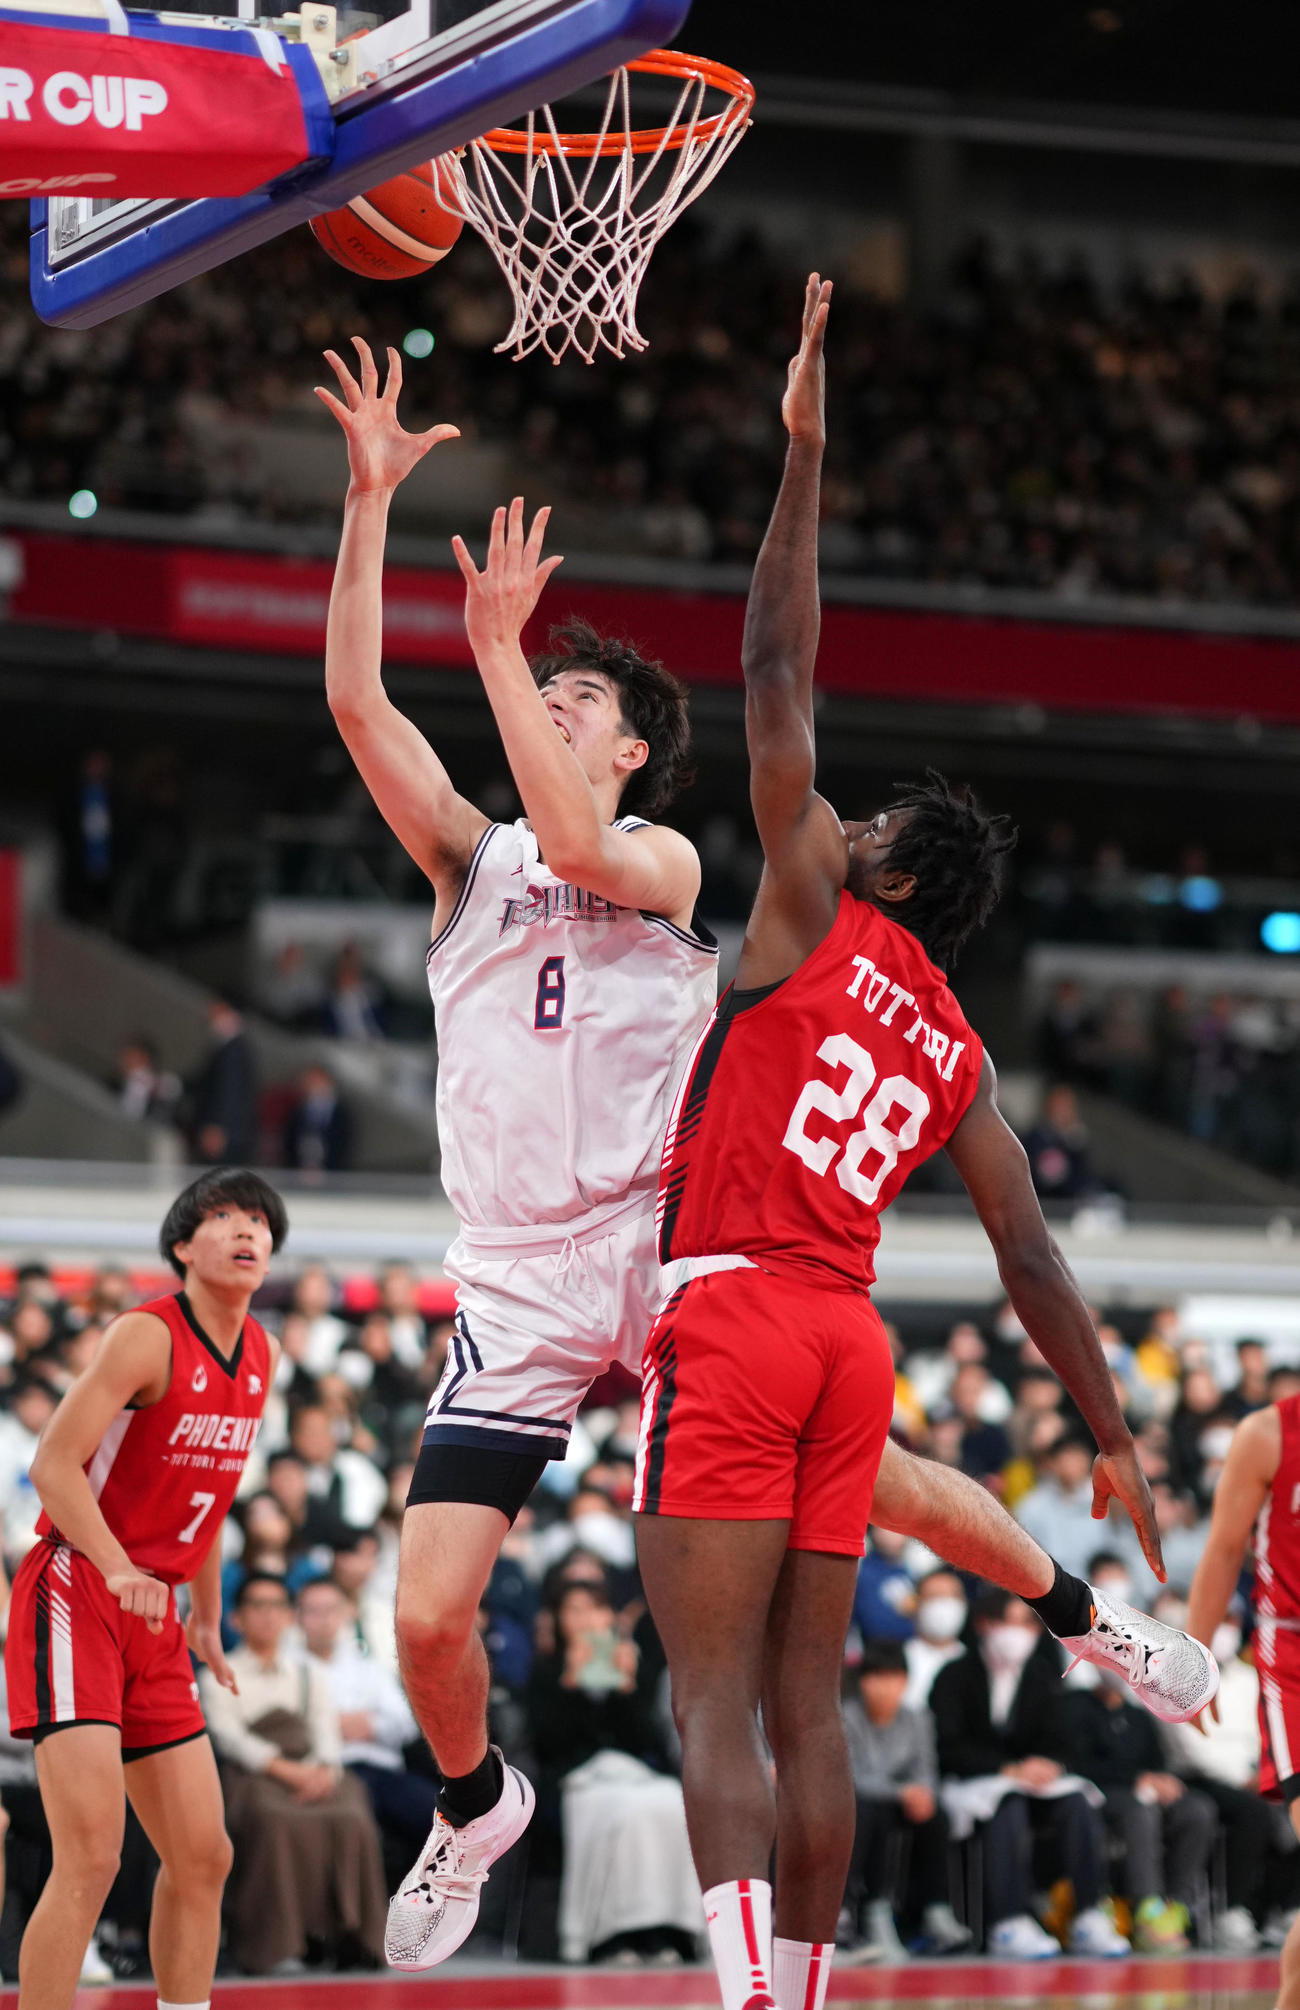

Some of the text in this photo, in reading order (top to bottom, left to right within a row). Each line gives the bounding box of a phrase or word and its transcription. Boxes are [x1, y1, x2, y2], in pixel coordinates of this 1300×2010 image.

[43, 71, 168, 131] CUP
[534, 955, 566, 1030] 8
[781, 1032, 931, 1206] 28
[177, 1491, 216, 1544] 7
